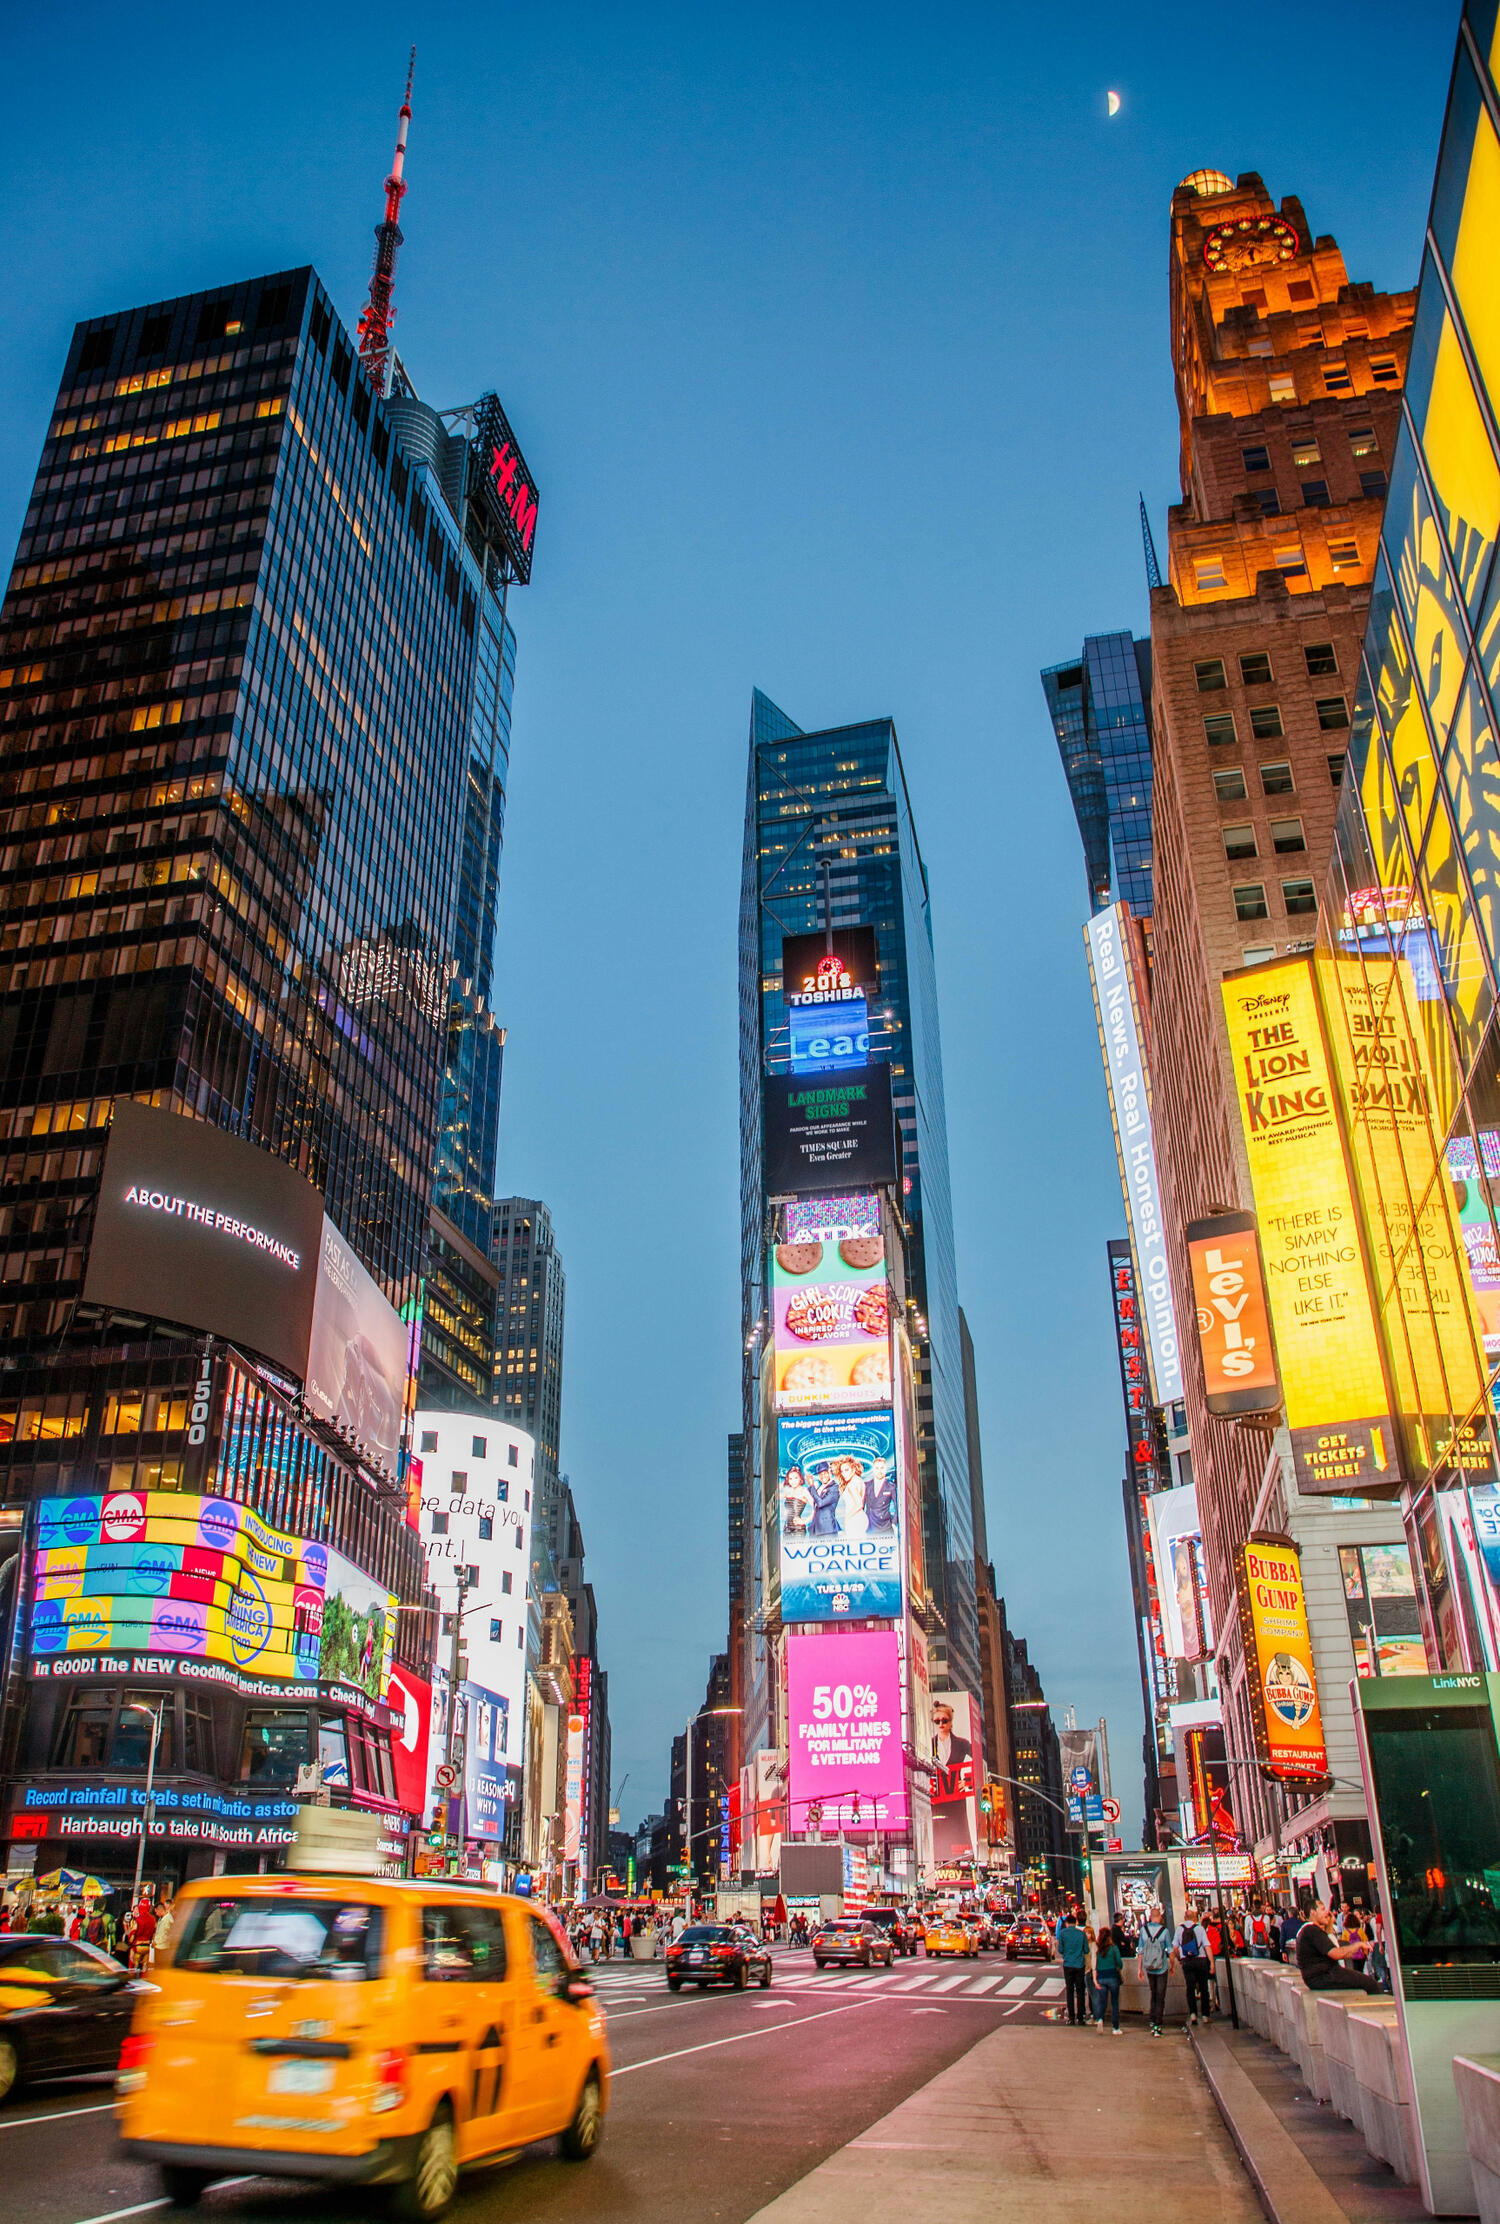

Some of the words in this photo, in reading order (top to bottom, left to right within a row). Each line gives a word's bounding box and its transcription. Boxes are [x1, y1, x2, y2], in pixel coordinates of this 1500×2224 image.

[490, 442, 537, 551] H&M
[1096, 920, 1121, 981] Real
[803, 972, 851, 992] 2018
[790, 986, 865, 1006] TOSHIBA
[1106, 983, 1129, 1067] News.
[1247, 1022, 1294, 1048] THE
[1244, 1050, 1310, 1089] LION
[788, 1085, 867, 1108] LANDMARK
[1119, 1070, 1146, 1136] Real
[806, 1102, 850, 1120] SIGNS
[1245, 1086, 1328, 1132] KING
[820, 1121, 852, 1129] APPEARANCE
[800, 1142, 825, 1153] TIMES
[826, 1139, 859, 1151] SQUARE
[809, 1153, 826, 1162] Even
[826, 1151, 852, 1161] Greater
[1130, 1141, 1162, 1248] Honest
[1327, 1206, 1343, 1221] IS
[125, 1186, 185, 1216] ABOUT
[185, 1201, 215, 1226] THE
[214, 1212, 300, 1271] PERFORMANCE
[1284, 1227, 1338, 1251] SIMPLY
[1269, 1246, 1356, 1275] NOTHING
[1298, 1272, 1333, 1292] ELSE
[791, 1286, 827, 1311] GIRL
[826, 1285, 868, 1306] SCOUT
[1294, 1296, 1325, 1316] LIKE
[795, 1325, 833, 1334] INSPIRED
[835, 1321, 867, 1331] COFFEE
[1148, 1255, 1179, 1387] Opinion.
[812, 1331, 850, 1340] FLAVORS
[1117, 1269, 1144, 1408] ERNST
[188, 1359, 211, 1445] 1500
[833, 1390, 876, 1400] DONUTS
[781, 1421, 795, 1429] The
[796, 1419, 823, 1429] biggest
[823, 1418, 846, 1426] dance
[846, 1415, 890, 1424] competition
[1318, 1433, 1347, 1449] GET
[1304, 1445, 1367, 1466] TICKETS
[1314, 1461, 1361, 1480] HERE!
[60, 1513, 100, 1527] GMA
[102, 1510, 143, 1525] GMA
[449, 1492, 496, 1520] data
[503, 1507, 525, 1528] you
[200, 1514, 235, 1536] GMA
[245, 1514, 293, 1556] INTRODUCING
[784, 1542, 876, 1559] WORLD
[879, 1545, 896, 1554] OF
[52, 1563, 81, 1580] GMA
[136, 1559, 173, 1576] GMA
[253, 1555, 277, 1573] NEW
[808, 1557, 894, 1574] DANCE
[1248, 1554, 1299, 1583] BUBBA
[1256, 1583, 1298, 1611] GUMP
[833, 1603, 850, 1612] NBC
[67, 1612, 106, 1629] GMA
[158, 1615, 200, 1634] GMA
[227, 1614, 264, 1638] AMERICA
[1263, 1616, 1298, 1627] SHRIMP
[1260, 1626, 1305, 1638] COMPANY
[53, 1656, 97, 1675] GOOD!
[100, 1656, 130, 1674] The
[133, 1657, 175, 1675] NEW
[330, 1686, 357, 1706] Check
[577, 1656, 590, 1699] Locker
[1432, 1676, 1481, 1689] LinkNYC
[812, 1684, 878, 1719] 50%
[1266, 1687, 1292, 1701] BUBBA
[1293, 1686, 1314, 1703] GUMP
[853, 1704, 878, 1718] OFF
[799, 1722, 848, 1738] FAMILY
[850, 1721, 891, 1737] LINES
[808, 1739, 831, 1752] FOR
[831, 1738, 883, 1751] MILITARY
[1272, 1749, 1324, 1760] RESTAURANT
[811, 1754, 820, 1766] &
[820, 1752, 880, 1765] VETERANS
[477, 1779, 505, 1800] REASONS
[25, 1787, 69, 1806] Record
[70, 1787, 128, 1805] rainfall
[130, 1788, 179, 1806] totals
[181, 1791, 202, 1808] set
[255, 1804, 271, 1816] as
[476, 1798, 492, 1814] WHY
[60, 1817, 143, 1838] Harbaugh
[148, 1821, 165, 1835] to
[169, 1819, 199, 1836] take
[219, 1825, 252, 1843] South
